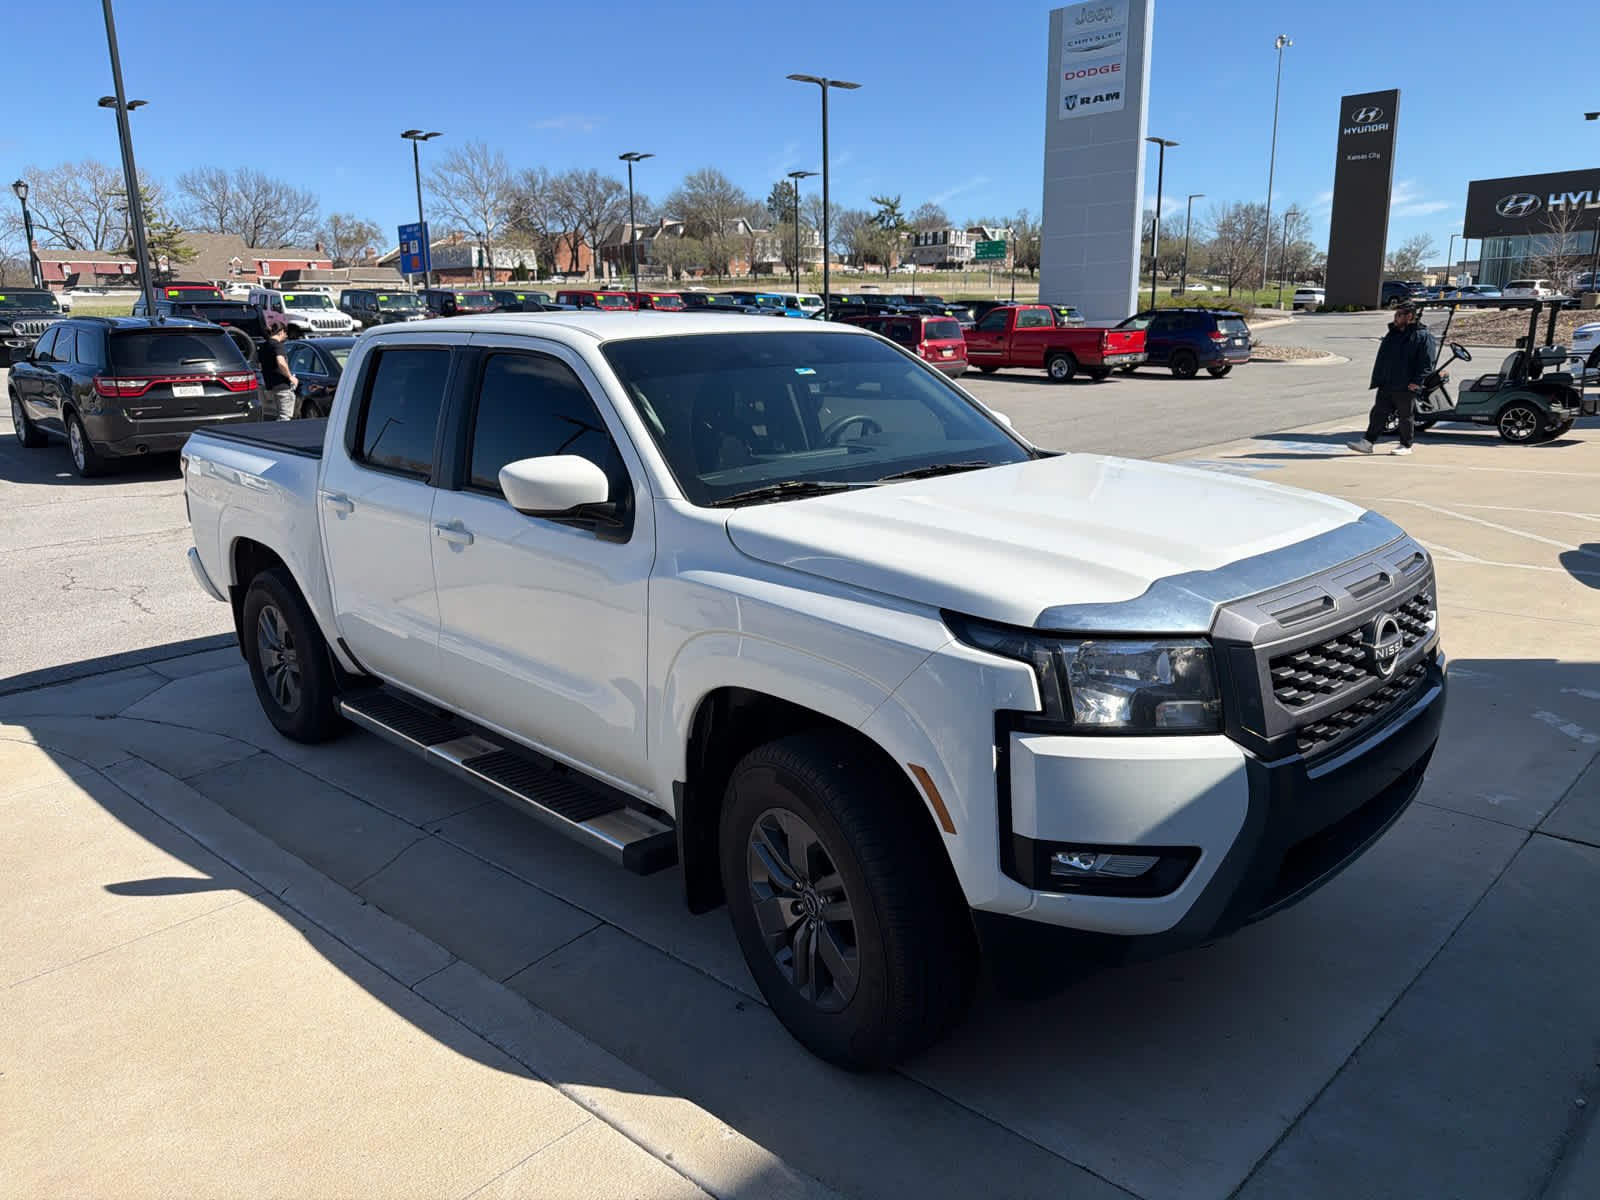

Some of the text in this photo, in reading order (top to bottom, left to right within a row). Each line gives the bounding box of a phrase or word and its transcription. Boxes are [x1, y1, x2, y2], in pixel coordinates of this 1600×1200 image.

[1074, 7, 1113, 26] Jeep
[1065, 63, 1121, 81] DODGE
[1079, 91, 1120, 106] RAM
[1343, 122, 1389, 135] HYUNDAI
